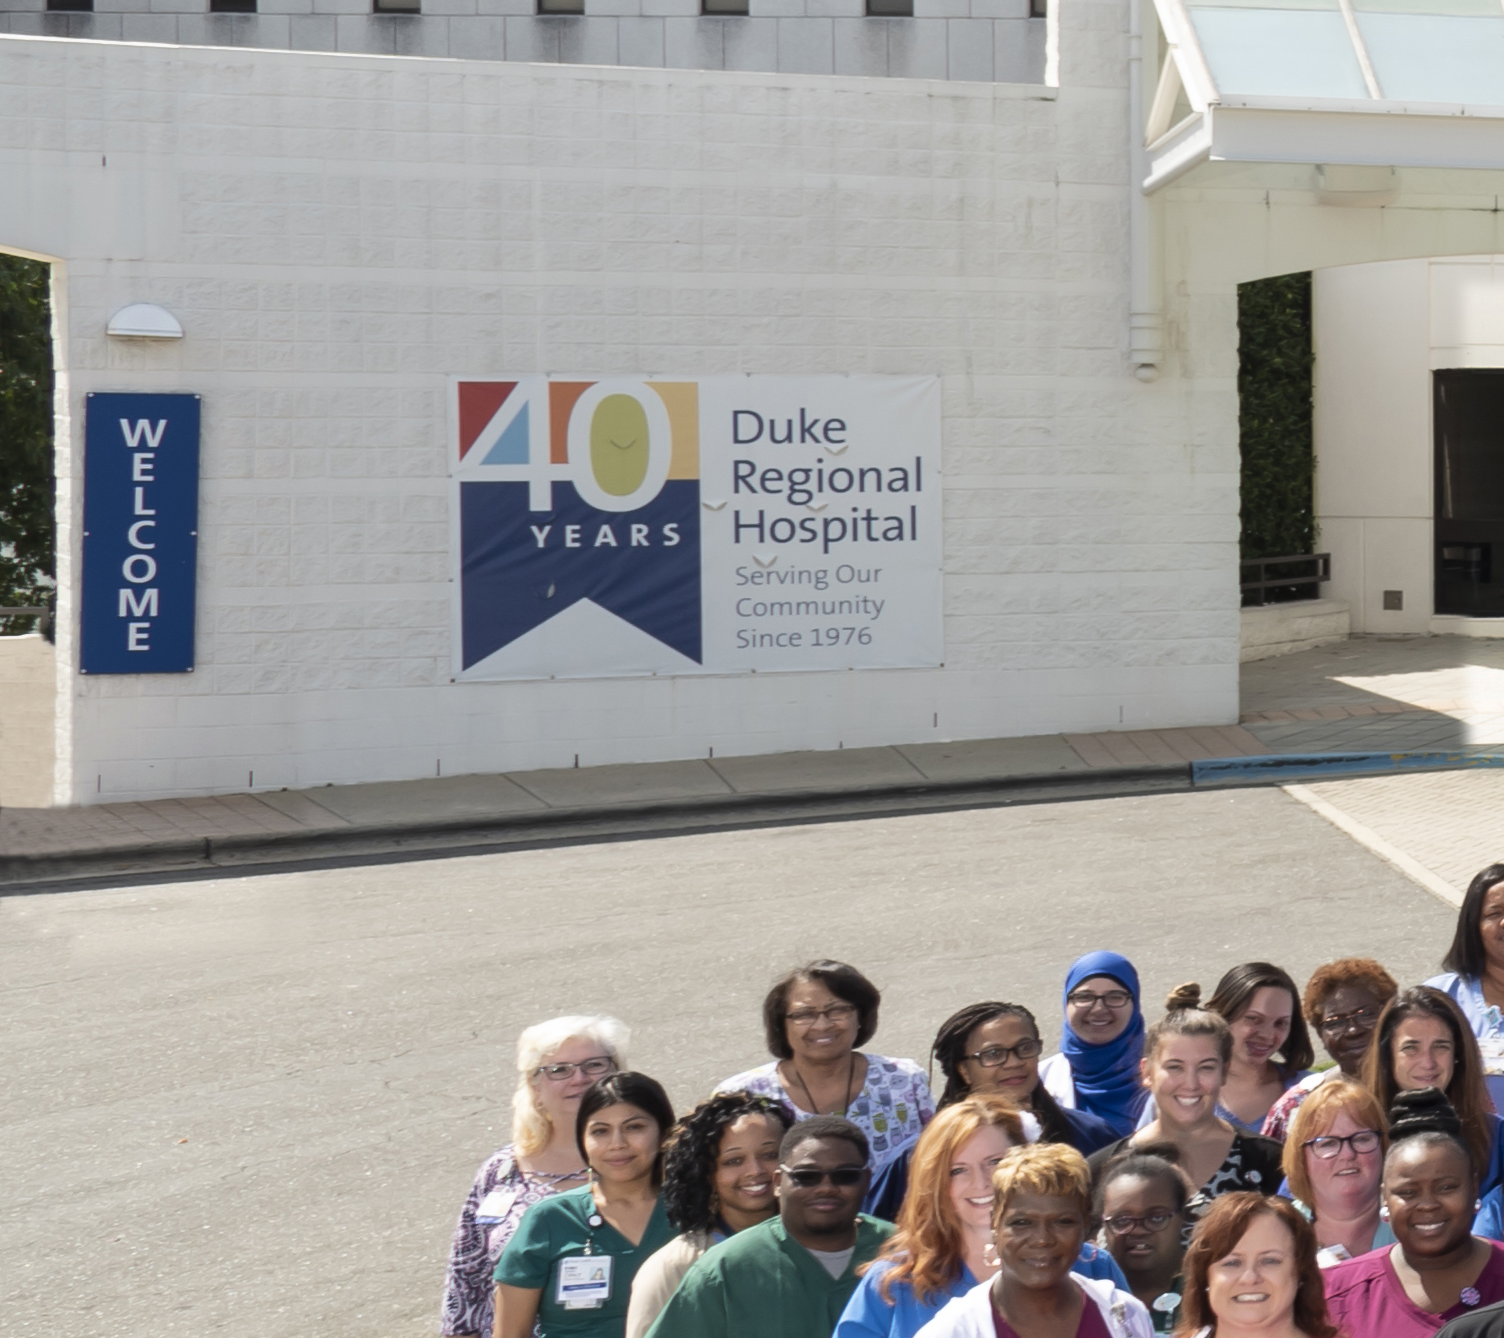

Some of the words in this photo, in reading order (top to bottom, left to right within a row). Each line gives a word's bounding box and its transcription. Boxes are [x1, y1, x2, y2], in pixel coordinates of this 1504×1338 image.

[732, 408, 847, 445] Duke
[458, 380, 674, 514] 40
[733, 457, 922, 501] Regional
[119, 418, 168, 651] WELCOME
[530, 522, 681, 549] YEARS
[733, 504, 917, 554] Hospital
[735, 562, 830, 590] Serving
[835, 563, 883, 585] Our
[735, 594, 886, 621] Community
[736, 626, 803, 649] Since
[810, 626, 873, 648] 1976
